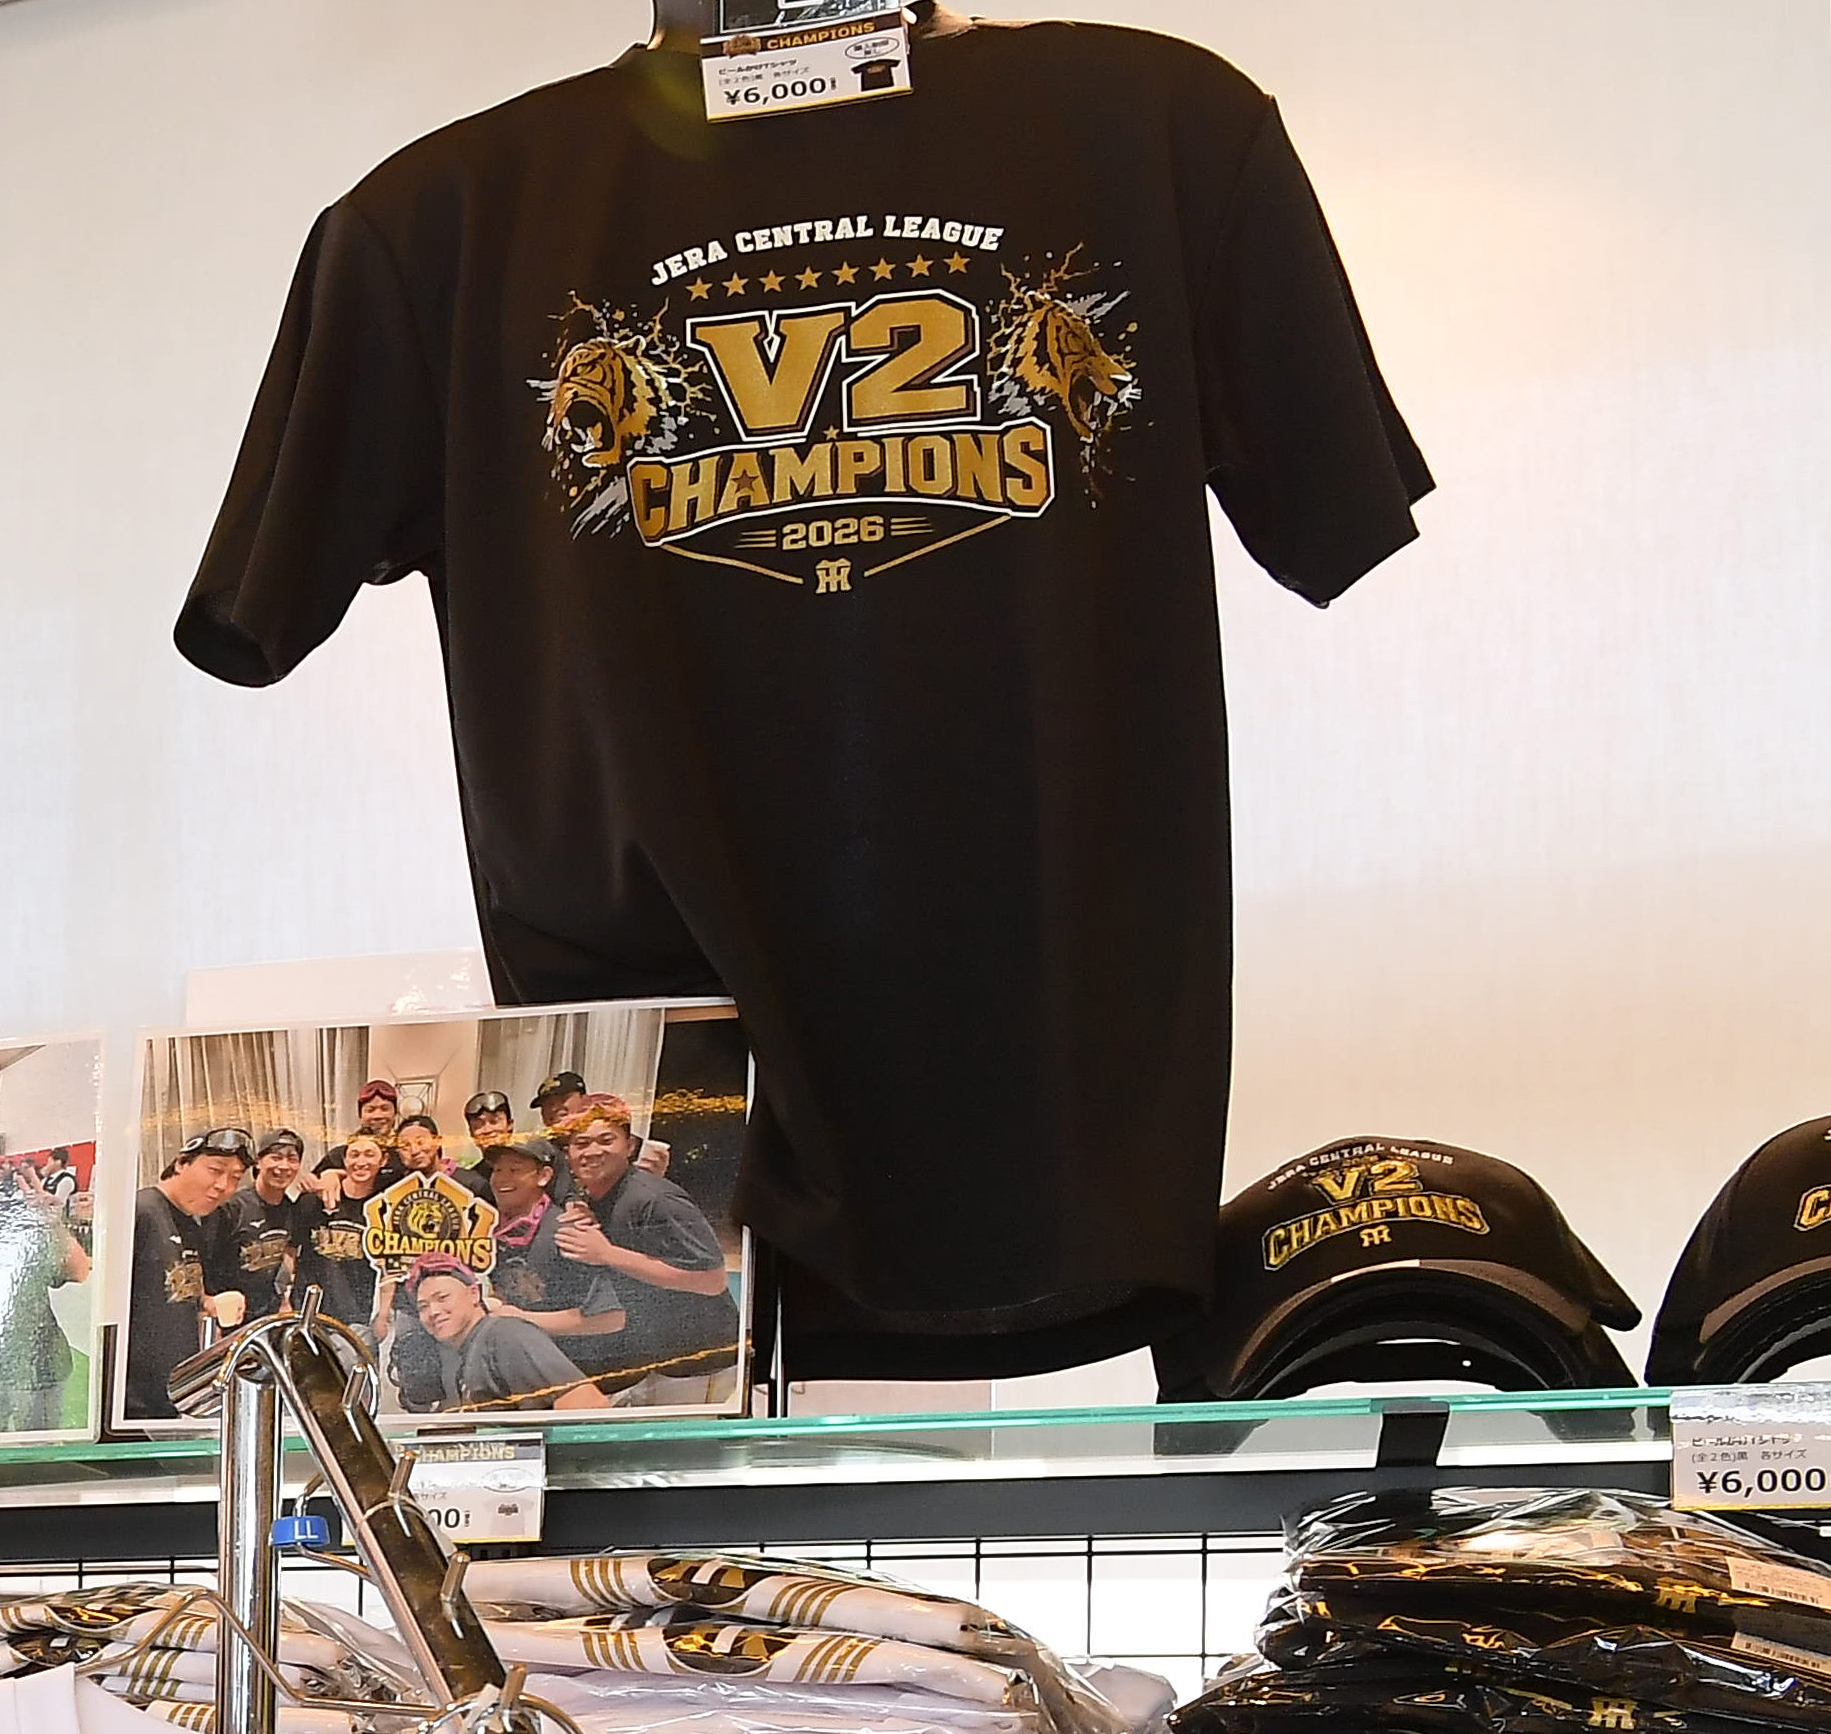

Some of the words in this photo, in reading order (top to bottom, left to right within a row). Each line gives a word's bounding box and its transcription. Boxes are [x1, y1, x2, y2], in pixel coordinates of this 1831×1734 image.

[767, 22, 875, 49] CHAMPIONS
[724, 77, 826, 106] ¥6,000
[650, 239, 728, 287] JERA
[734, 215, 873, 254] CENTRAL
[883, 215, 1003, 253] LEAGUE
[689, 290, 978, 440] V2
[631, 424, 1050, 544] CHAMPIONS
[781, 515, 885, 551] 2026
[1309, 1142, 1385, 1167] CENTRAL
[1390, 1145, 1454, 1165] LEAGUE
[1315, 1159, 1422, 1203] V2
[366, 1226, 492, 1270] CHAMPIONS
[1265, 1194, 1487, 1269] CHAMPIONS
[1696, 1468, 1827, 1498] ¥6,000
[294, 1520, 319, 1540] LL
